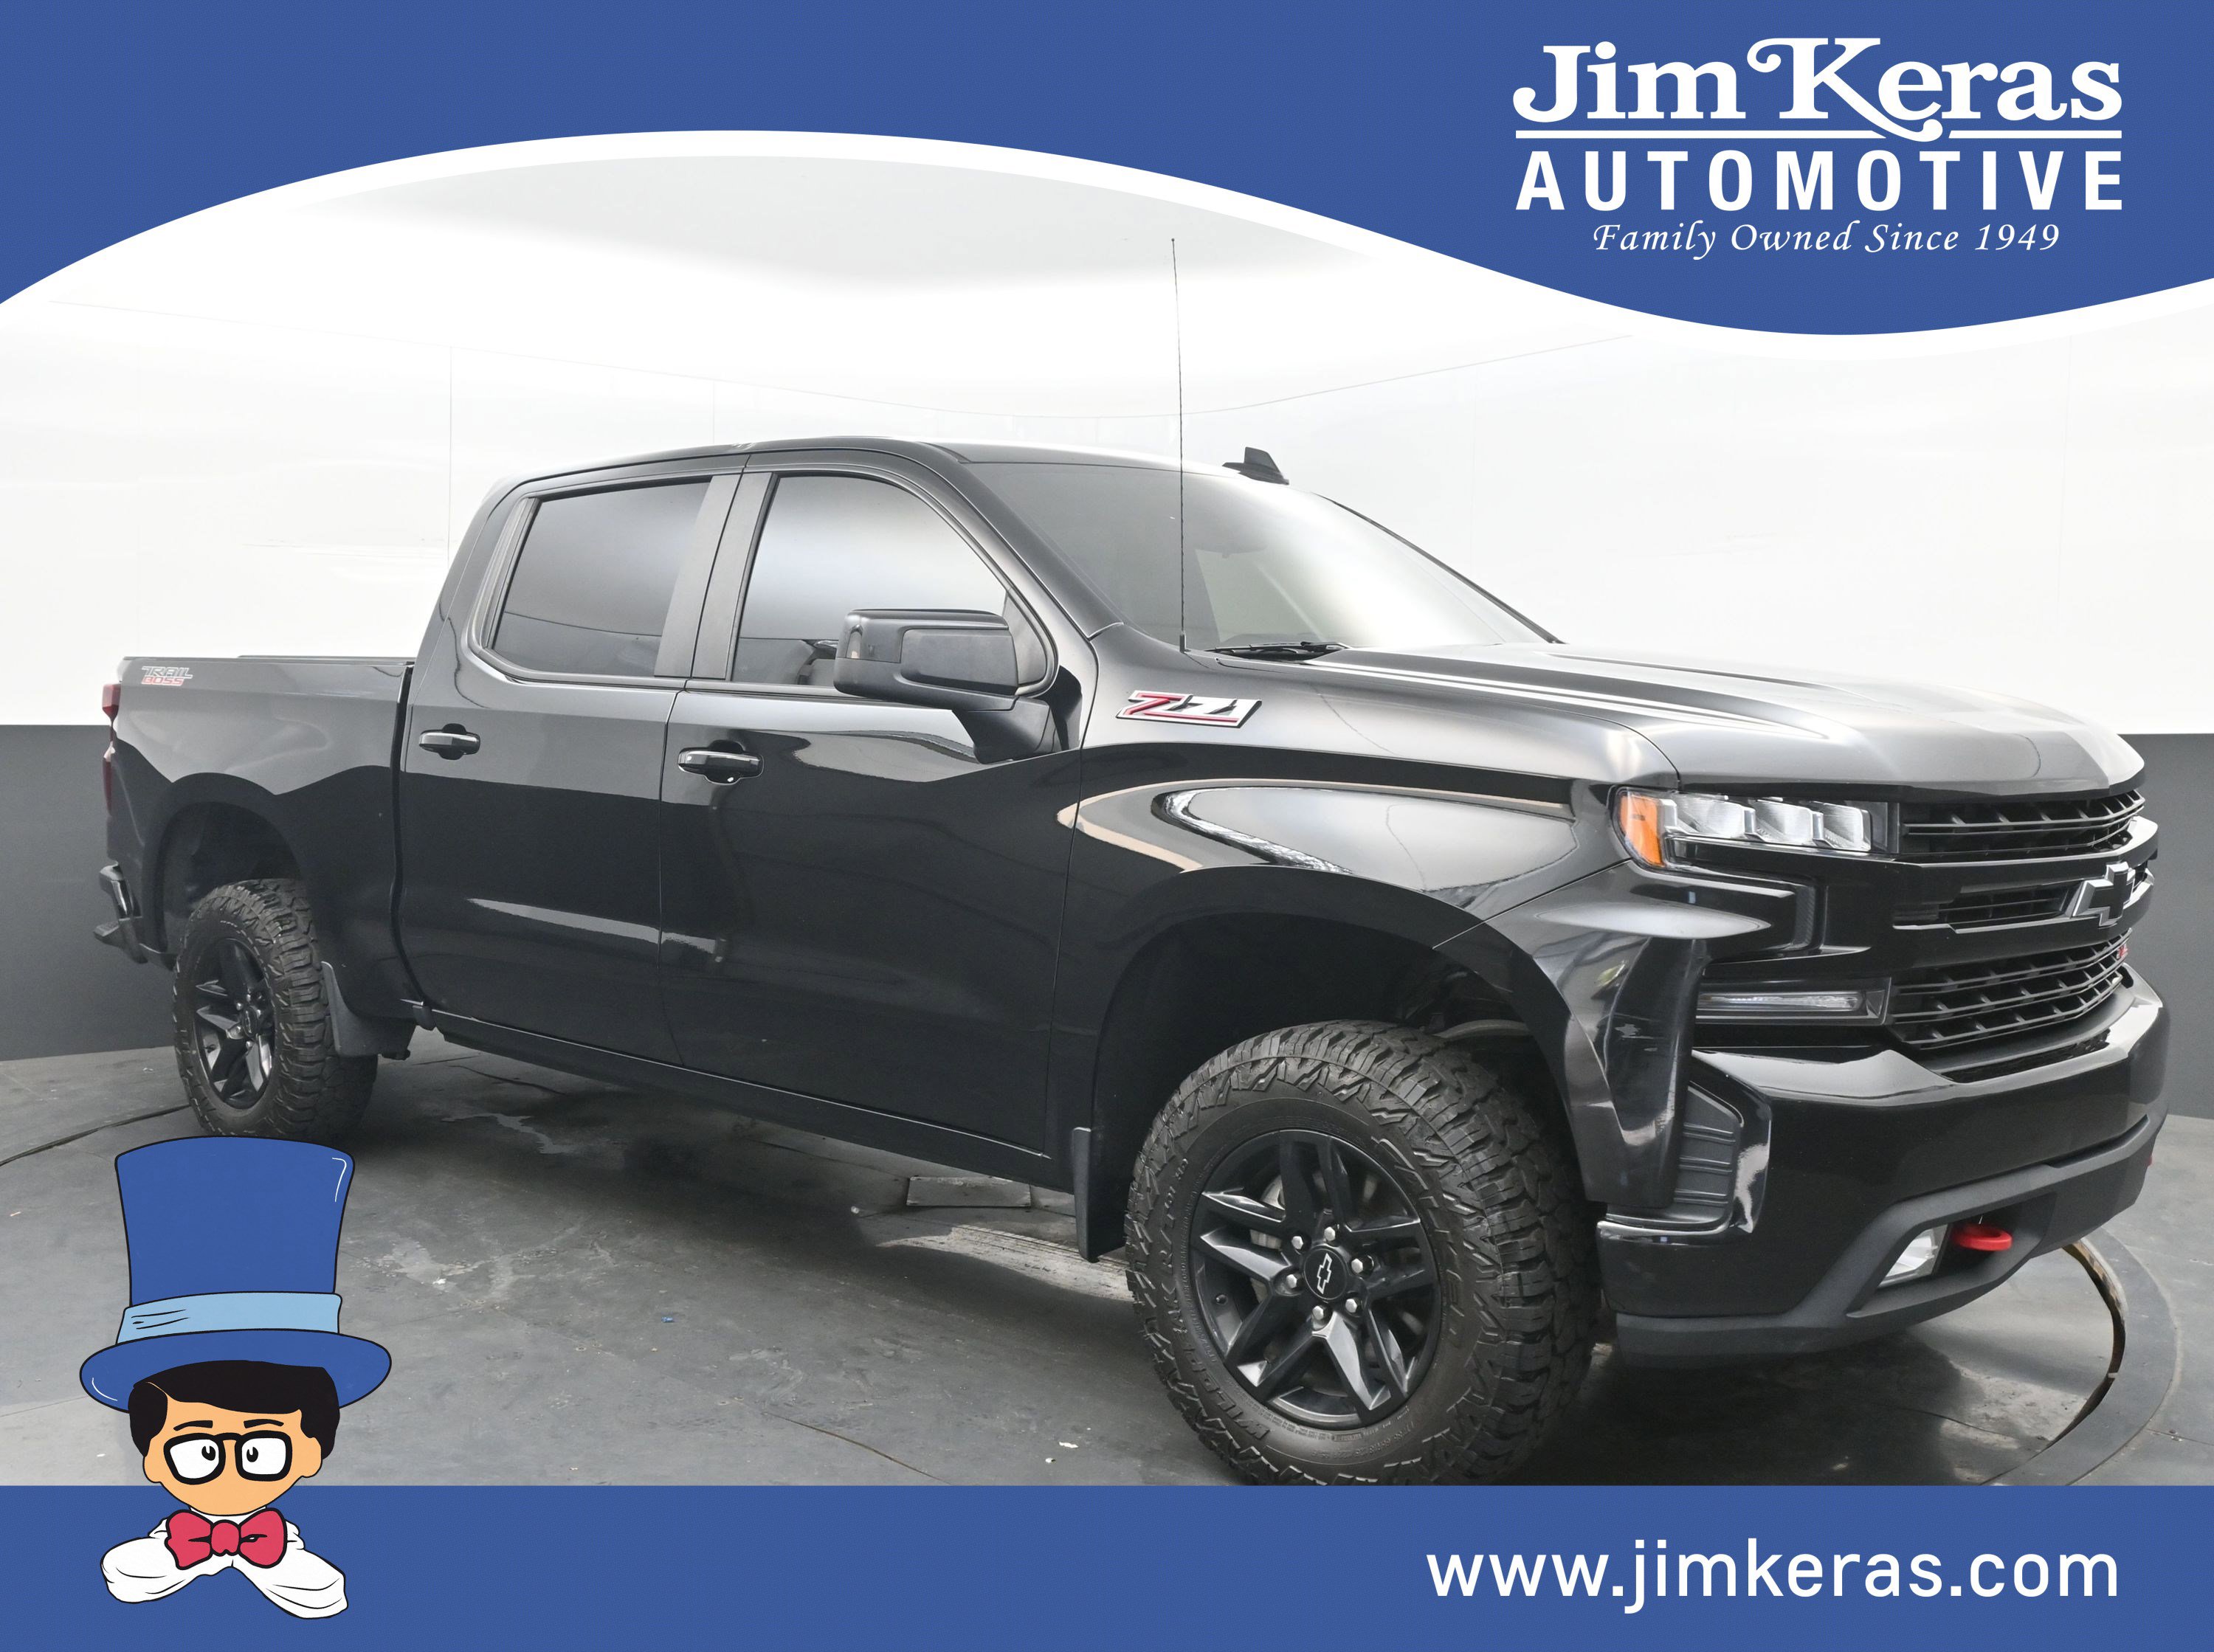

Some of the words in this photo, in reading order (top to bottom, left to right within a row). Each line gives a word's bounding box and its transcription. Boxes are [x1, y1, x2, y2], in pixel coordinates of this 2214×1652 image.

[141, 666, 193, 680] TRAIL
[141, 676, 185, 687] BOSS
[1115, 690, 1263, 729] Z71
